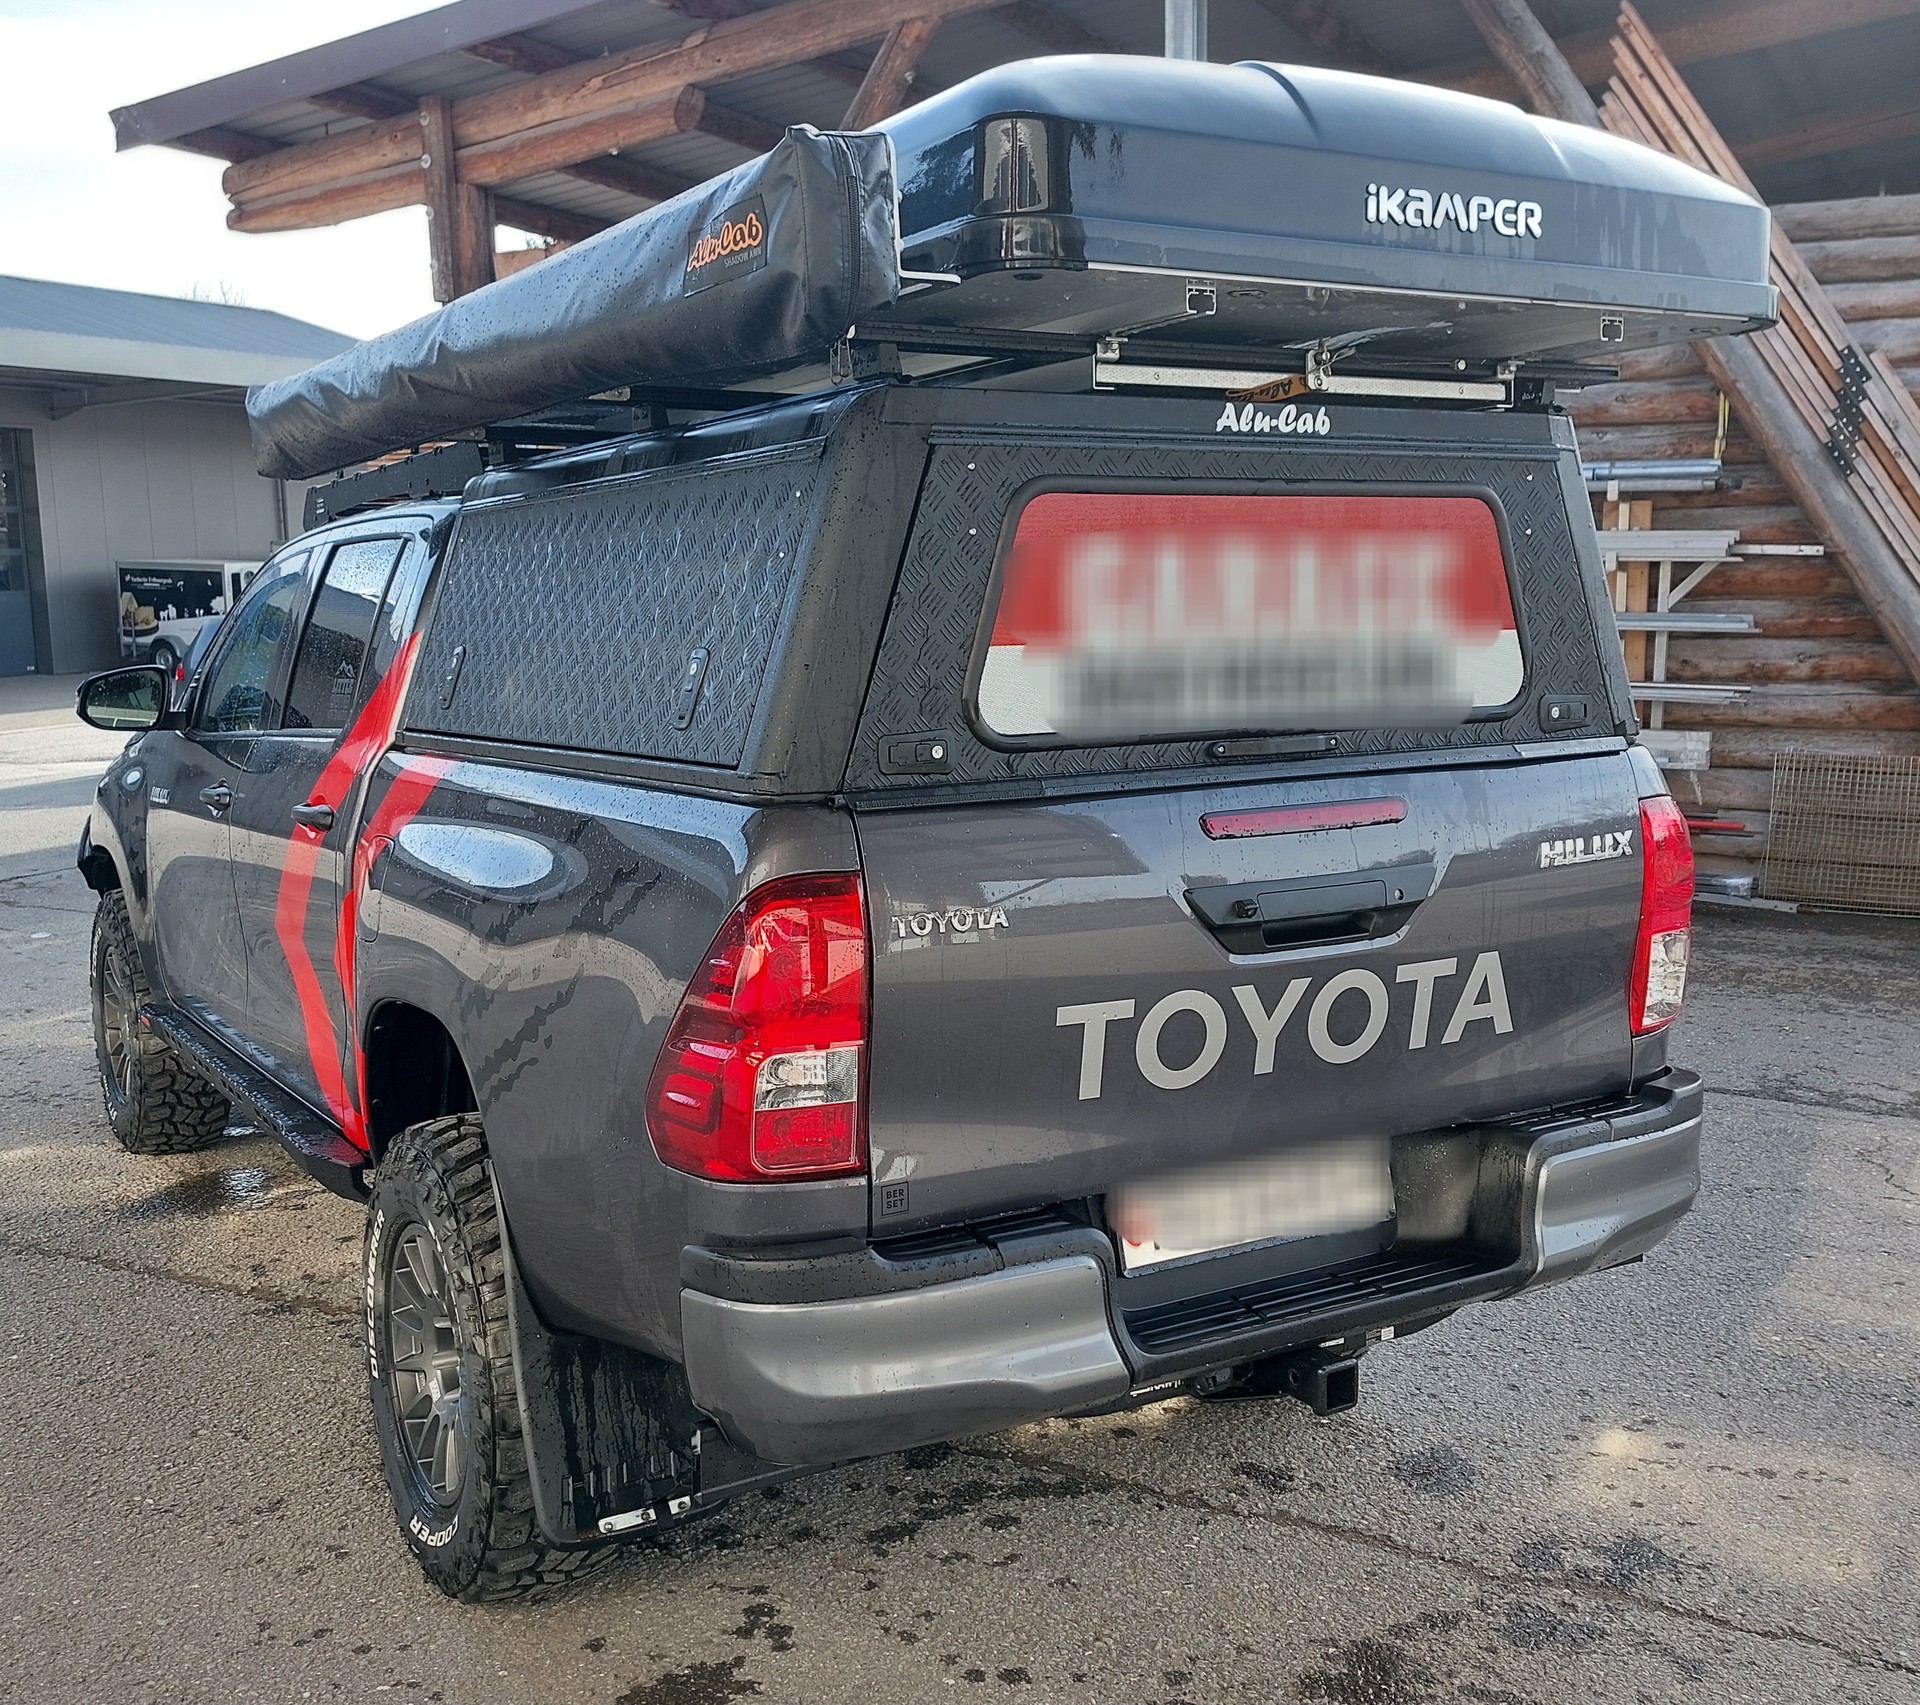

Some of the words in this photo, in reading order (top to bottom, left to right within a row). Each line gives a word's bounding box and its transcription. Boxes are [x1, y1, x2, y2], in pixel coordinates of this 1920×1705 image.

[1215, 402, 1331, 436] Alu-Cab
[1540, 829, 1634, 869] HILUX
[891, 904, 1010, 938] TOYOTA
[1056, 950, 1514, 1100] TOYOTA
[886, 1188, 905, 1200] BER
[886, 1198, 905, 1209] SET
[366, 1208, 386, 1380] DISCOVERER
[409, 1513, 459, 1547] COOPER
